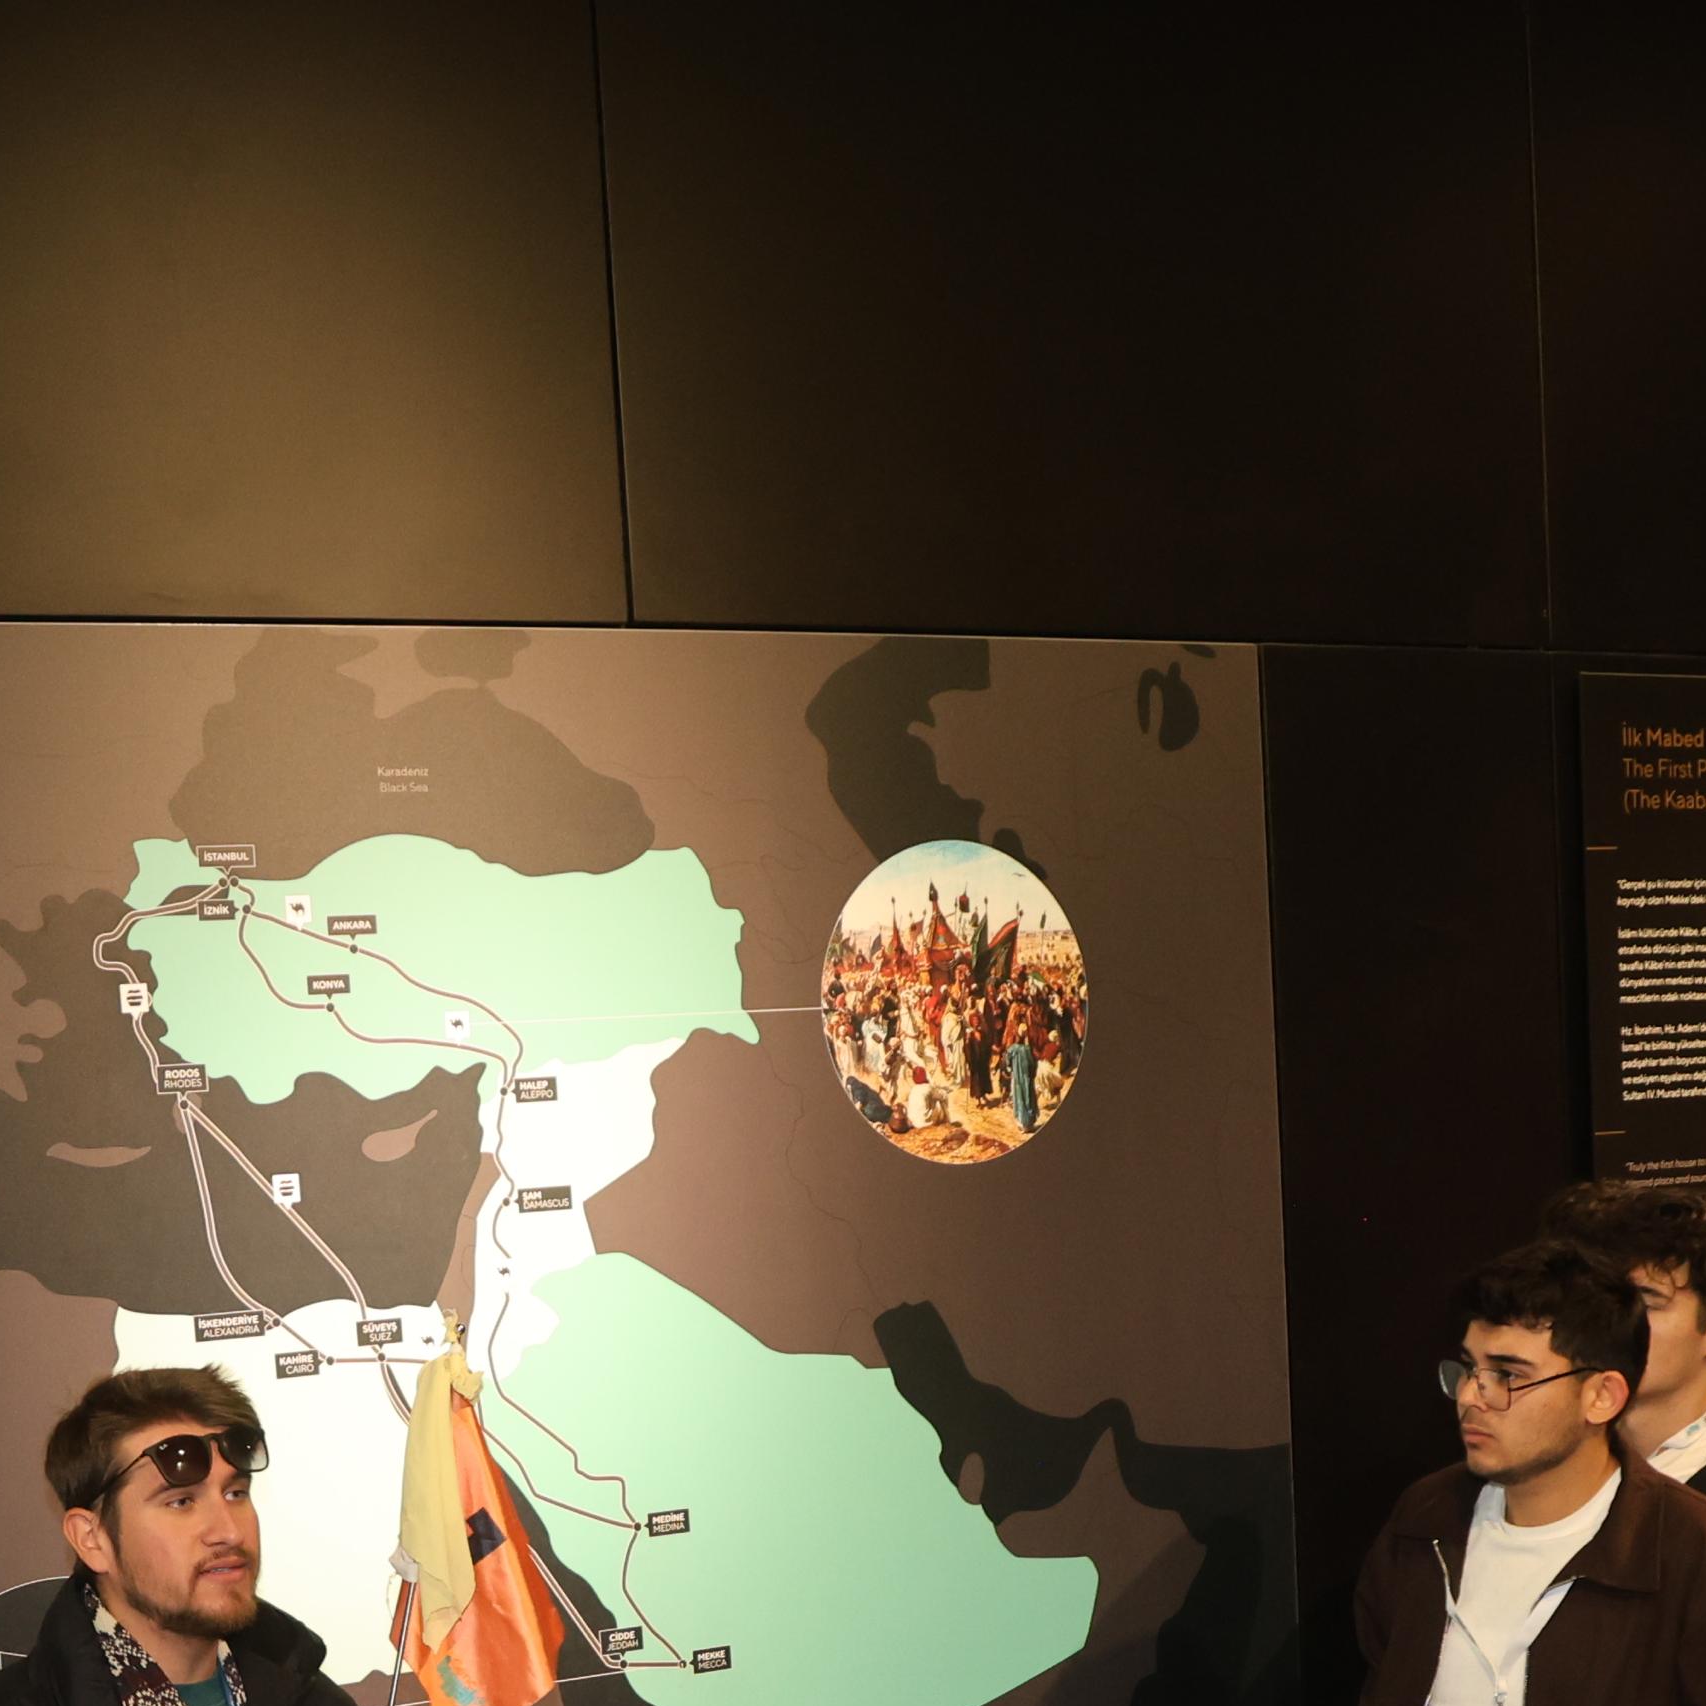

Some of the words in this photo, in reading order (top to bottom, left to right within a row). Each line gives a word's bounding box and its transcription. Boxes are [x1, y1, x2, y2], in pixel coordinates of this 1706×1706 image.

[1622, 722, 1643, 749] İlk
[1646, 728, 1704, 749] Mabed
[377, 766, 429, 777] Karadeniz
[1623, 759, 1654, 779] The
[1658, 761, 1693, 778] First
[379, 782, 407, 792] Black
[409, 782, 429, 792] Sea
[1624, 790, 1661, 813] (The
[204, 852, 250, 862] İSTANBUL
[204, 904, 230, 915] İZNİK
[333, 921, 372, 930] ANKARA
[312, 979, 345, 990] KONYA
[165, 1068, 200, 1079] RODOS
[164, 1079, 203, 1088] RHODES
[519, 1080, 549, 1091] HALEP
[520, 1090, 554, 1100] ALEPPO
[523, 1198, 570, 1210] DAMASCUS
[203, 1326, 261, 1338] ALEXANDRIA
[369, 1333, 392, 1342] SUEZ
[279, 1354, 314, 1365] KAHİRE
[286, 1364, 315, 1374] CAIRO
[652, 1513, 686, 1525] MEDİNE
[653, 1522, 686, 1533] MEDINA
[608, 1640, 639, 1651] JEDDAH
[697, 1651, 726, 1661] MEKKE
[698, 1659, 728, 1670] MECCA
